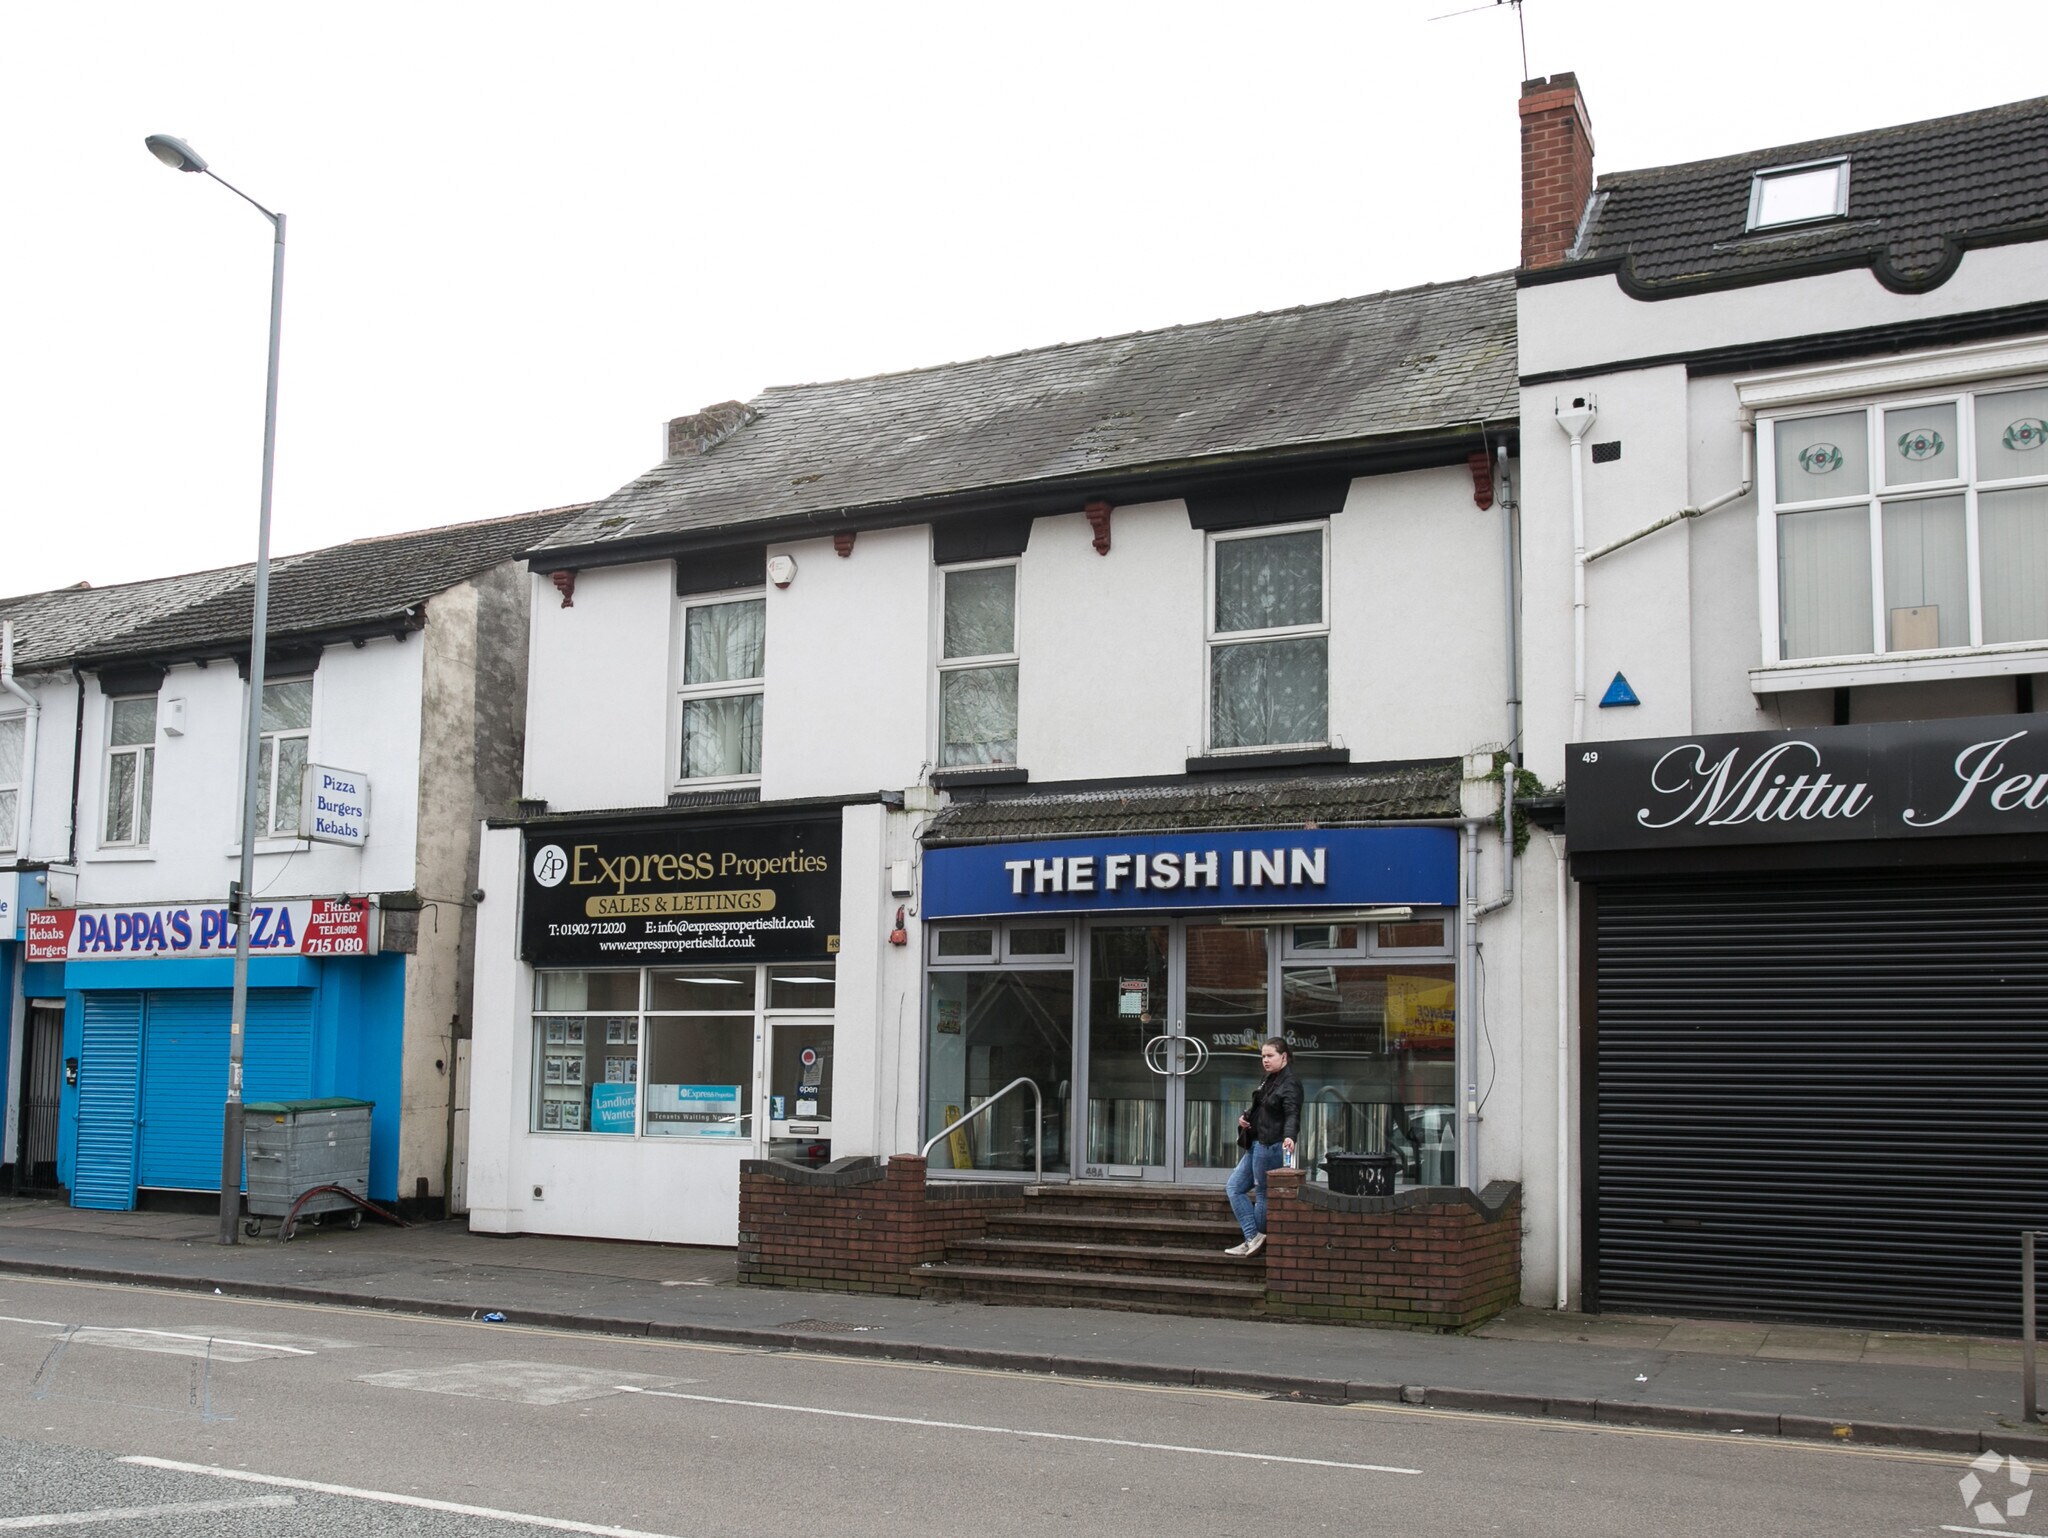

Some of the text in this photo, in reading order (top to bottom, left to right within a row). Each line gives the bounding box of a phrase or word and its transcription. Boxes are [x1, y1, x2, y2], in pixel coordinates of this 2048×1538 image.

[1581, 751, 1599, 763] 49
[323, 774, 356, 794] Pizza
[1637, 740, 1873, 828] Mittu
[317, 796, 363, 817] Burgers
[316, 818, 359, 837] Kebabs
[569, 844, 828, 895] Express Properties
[1005, 848, 1327, 894] THE FISH INN
[598, 892, 762, 915] SALES & LETTINGS
[29, 912, 57, 925] Pizza
[312, 912, 363, 924] DELIVERY
[657, 916, 816, 936] info@expresspropertiesltd.co.uk
[29, 928, 64, 940] Kebabs
[77, 906, 296, 953] PAPPA'S PIZA
[560, 922, 590, 936] 01902
[591, 922, 627, 935] 712020
[29, 944, 67, 957] Burgers
[307, 937, 364, 953] 715 080
[599, 935, 756, 953] www.expresspropertiesltd.co.uk
[829, 938, 840, 948] 48
[687, 1088, 714, 1100] Express
[799, 1085, 818, 1094] open
[654, 1113, 681, 1121] Tenants
[683, 1113, 710, 1122] Waiting
